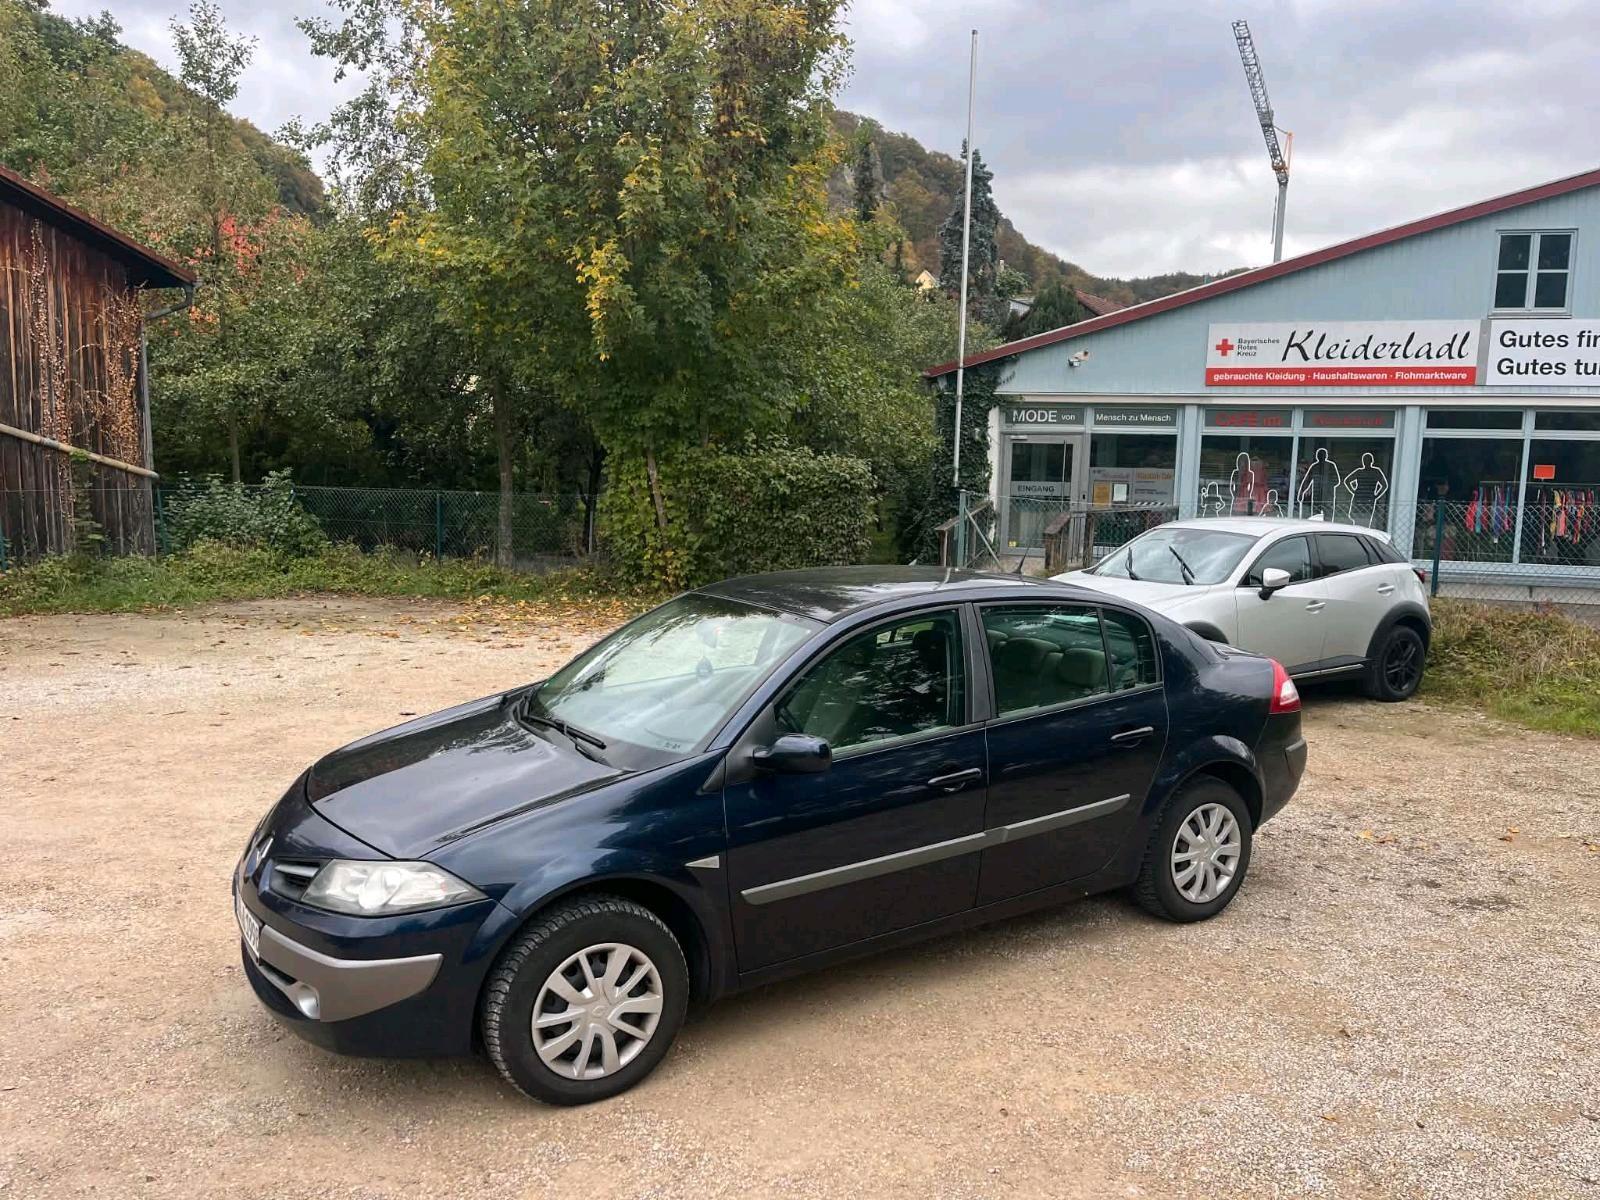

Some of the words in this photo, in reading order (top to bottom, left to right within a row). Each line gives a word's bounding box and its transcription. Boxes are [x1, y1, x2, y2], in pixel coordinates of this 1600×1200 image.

[1237, 338, 1280, 346] Bayerisches
[1281, 329, 1470, 361] Kleiderladl
[1499, 330, 1569, 348] Gutes
[1497, 358, 1567, 375] Gutes
[1213, 373, 1264, 382] gebrauchte
[1265, 373, 1305, 382] Kleidung
[1312, 372, 1388, 381] Haushaltswaren
[1395, 371, 1468, 380] Flohmarktware
[1012, 409, 1058, 423] MODE
[1095, 413, 1127, 421] Mensch
[1140, 414, 1172, 422] Mensch
